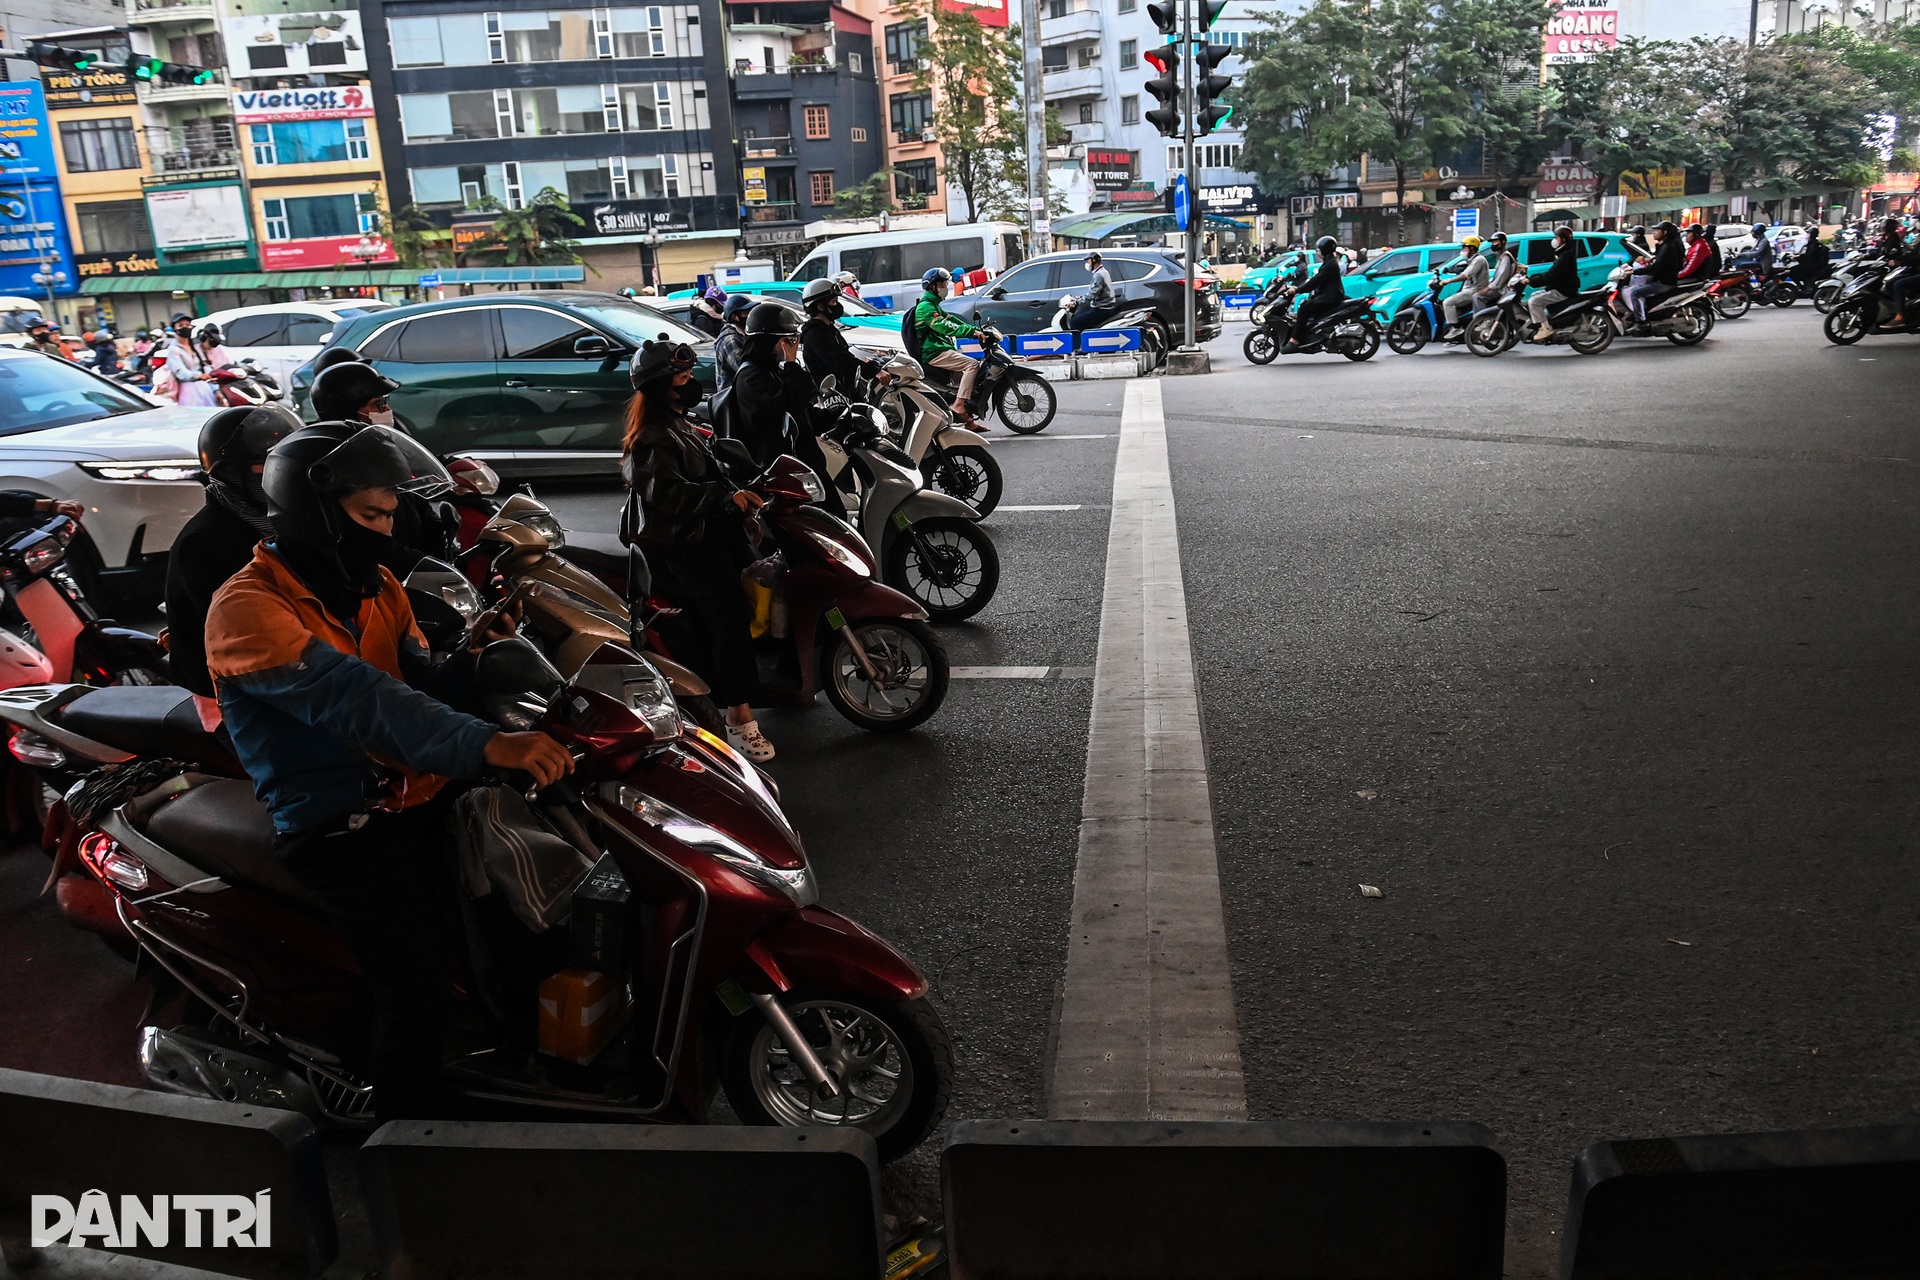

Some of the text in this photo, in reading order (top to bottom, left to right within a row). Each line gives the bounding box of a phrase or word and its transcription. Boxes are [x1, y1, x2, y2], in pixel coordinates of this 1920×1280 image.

[1548, 9, 1615, 35] HOÀNG
[1104, 171, 1129, 180] TOWER
[653, 212, 671, 223] 407
